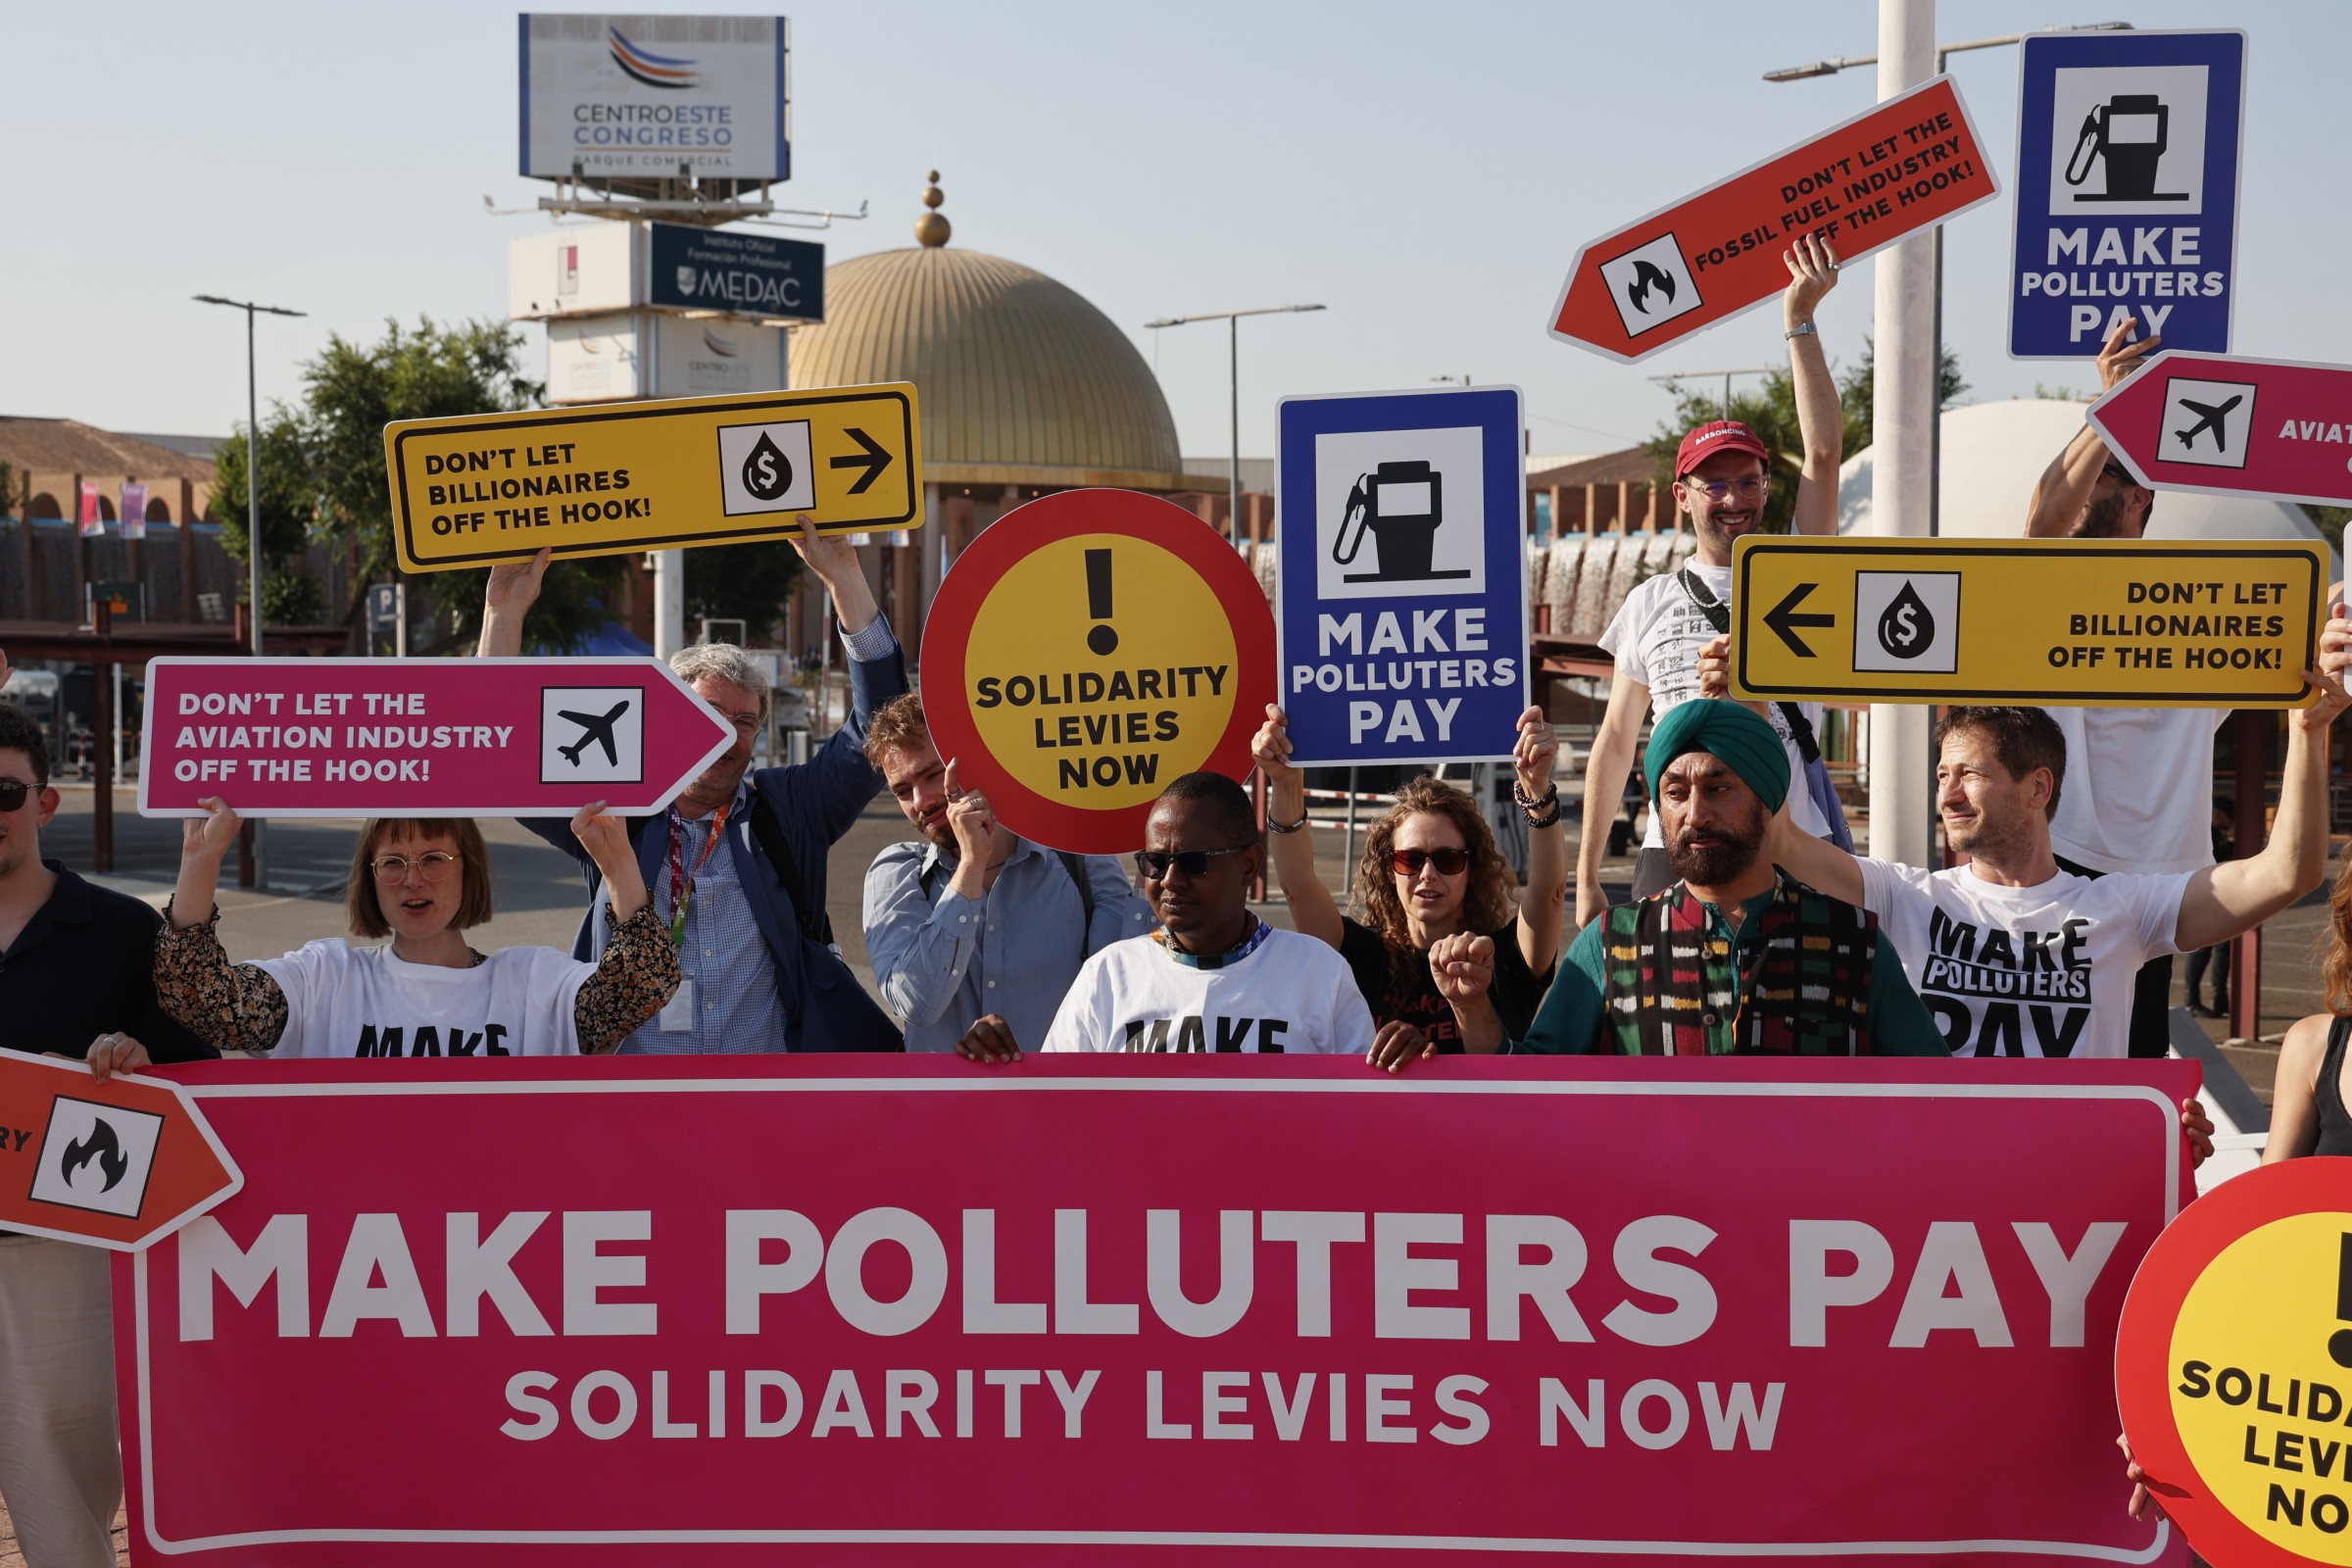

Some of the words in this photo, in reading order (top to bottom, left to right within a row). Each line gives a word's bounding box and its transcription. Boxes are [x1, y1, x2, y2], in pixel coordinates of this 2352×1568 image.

[573, 103, 732, 124] CENTROESTE
[573, 125, 732, 146] CONGRESO
[1781, 158, 1851, 204] DON'T
[1858, 135, 1898, 168] LET
[1904, 112, 1954, 144] THE
[1694, 224, 1778, 272] FOSSIL
[1781, 196, 1840, 232] FUEL
[1843, 135, 1960, 203] INDUSTRY
[1843, 198, 1893, 229] THE
[1897, 160, 1975, 207] HOOK!
[2048, 227, 2201, 266] MAKE
[698, 269, 801, 307] MEDAC
[2023, 271, 2224, 297] POLLUTERS
[2071, 306, 2174, 343] PAY
[425, 449, 515, 474] DON'T
[527, 444, 575, 466] LET
[429, 469, 630, 505] BILLIONAIRES
[432, 513, 485, 535] OFF
[494, 507, 551, 530] THE
[562, 498, 652, 523] HOOK!
[379, 589, 392, 612] P
[2128, 582, 2224, 605] DON'T
[2234, 583, 2288, 604] LET
[1319, 609, 1489, 656] MAKE
[2071, 614, 2284, 637] BILLIONAIRES
[1294, 659, 1516, 693] POLLUTERS
[2048, 647, 2106, 668] OFF
[2115, 647, 2173, 668] THE
[2185, 648, 2281, 669] HOOK!
[178, 693, 284, 715] DON'T
[296, 694, 353, 715] LET
[363, 694, 425, 715] THE
[976, 665, 1229, 708] SOLIDARITY
[175, 726, 332, 749] AVIATION
[347, 726, 514, 749] INDUSTRY
[1035, 710, 1180, 748] LEVIES
[1349, 698, 1462, 744] PAY
[175, 760, 238, 782] OFF
[248, 760, 312, 782] THE
[325, 760, 430, 782] HOOK!
[1059, 754, 1159, 789] NOW
[1930, 905, 2092, 971] MAKE
[1927, 958, 2086, 999] POLLUTERS
[355, 1023, 511, 1058] MAKE
[1125, 1015, 1289, 1054] MAKE
[178, 1210, 657, 1343] MAKE
[726, 1207, 1718, 1348] POLLUTERS
[1789, 1220, 2128, 1348] PAY
[500, 1370, 1102, 1441] SOLIDARITY
[1147, 1371, 1490, 1445] LEVIES
[1540, 1378, 1786, 1450] NOW
[2179, 1360, 2352, 1427] SOLID
[2267, 1484, 2350, 1534] NO
